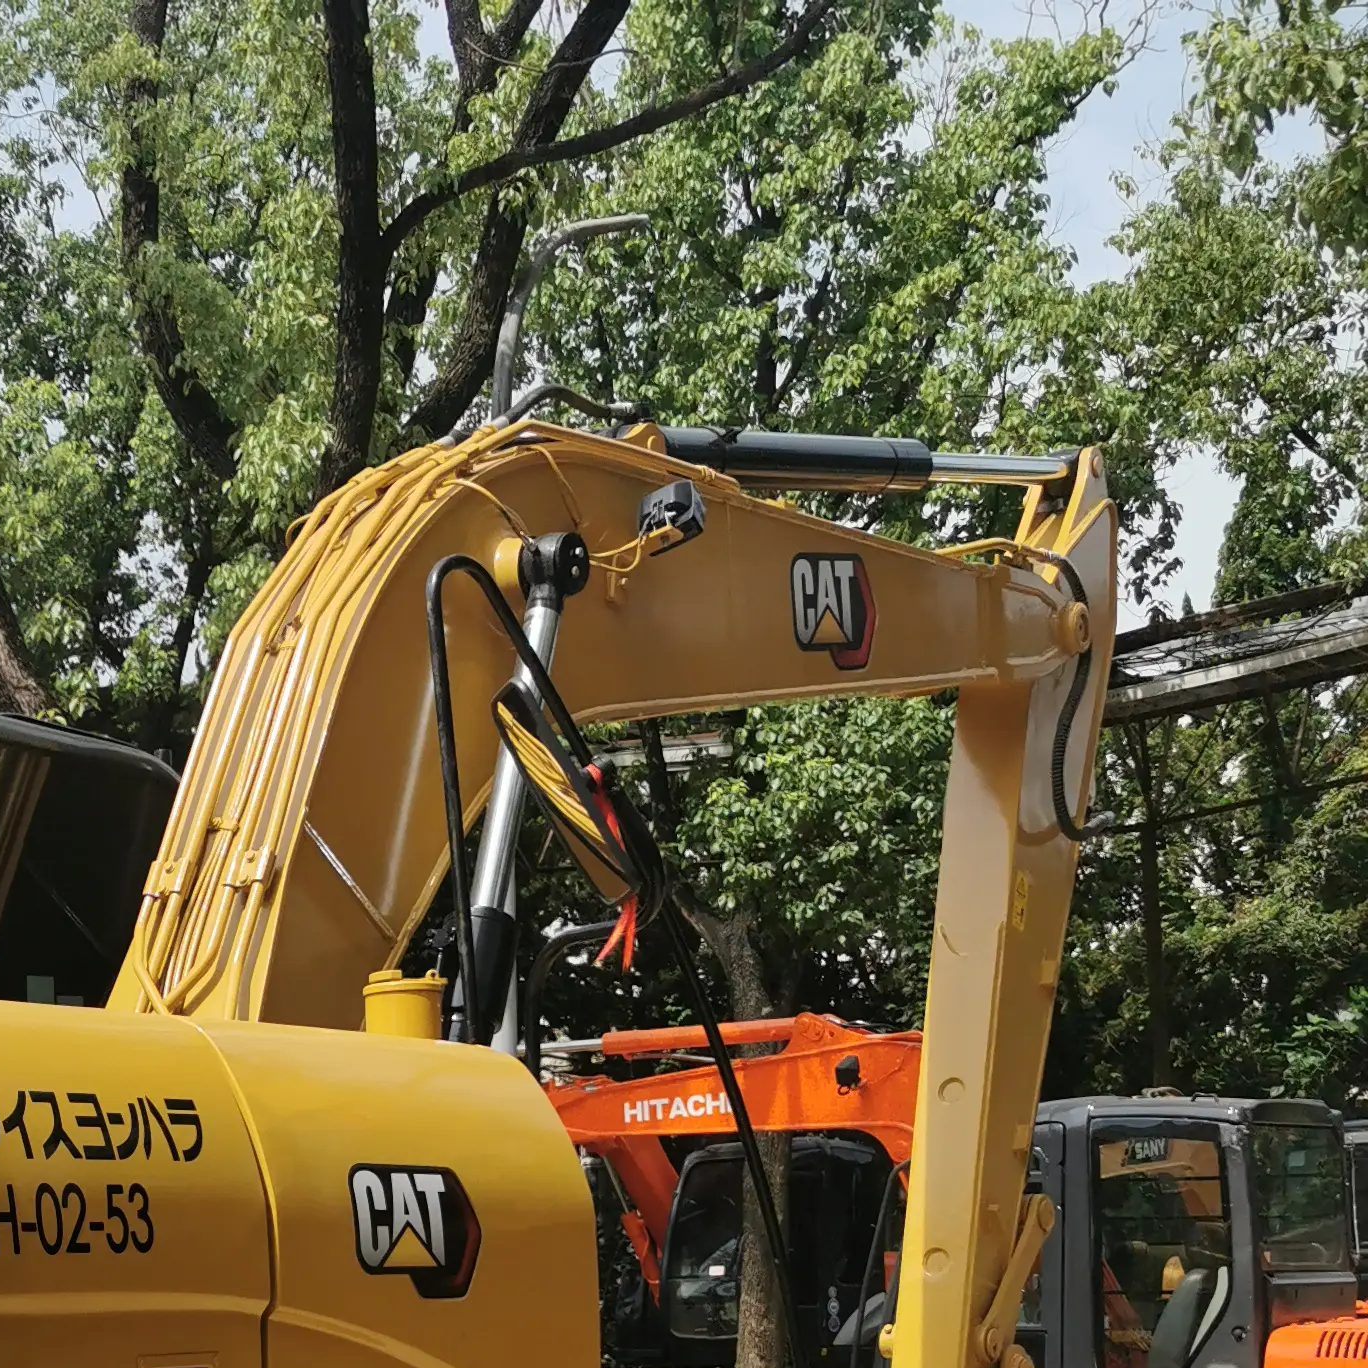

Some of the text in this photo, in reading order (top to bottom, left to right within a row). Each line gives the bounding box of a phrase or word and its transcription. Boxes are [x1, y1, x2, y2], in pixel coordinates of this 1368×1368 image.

[793, 558, 854, 644] CAT
[1134, 1138, 1166, 1160] SANY
[352, 1169, 446, 1267] CAT
